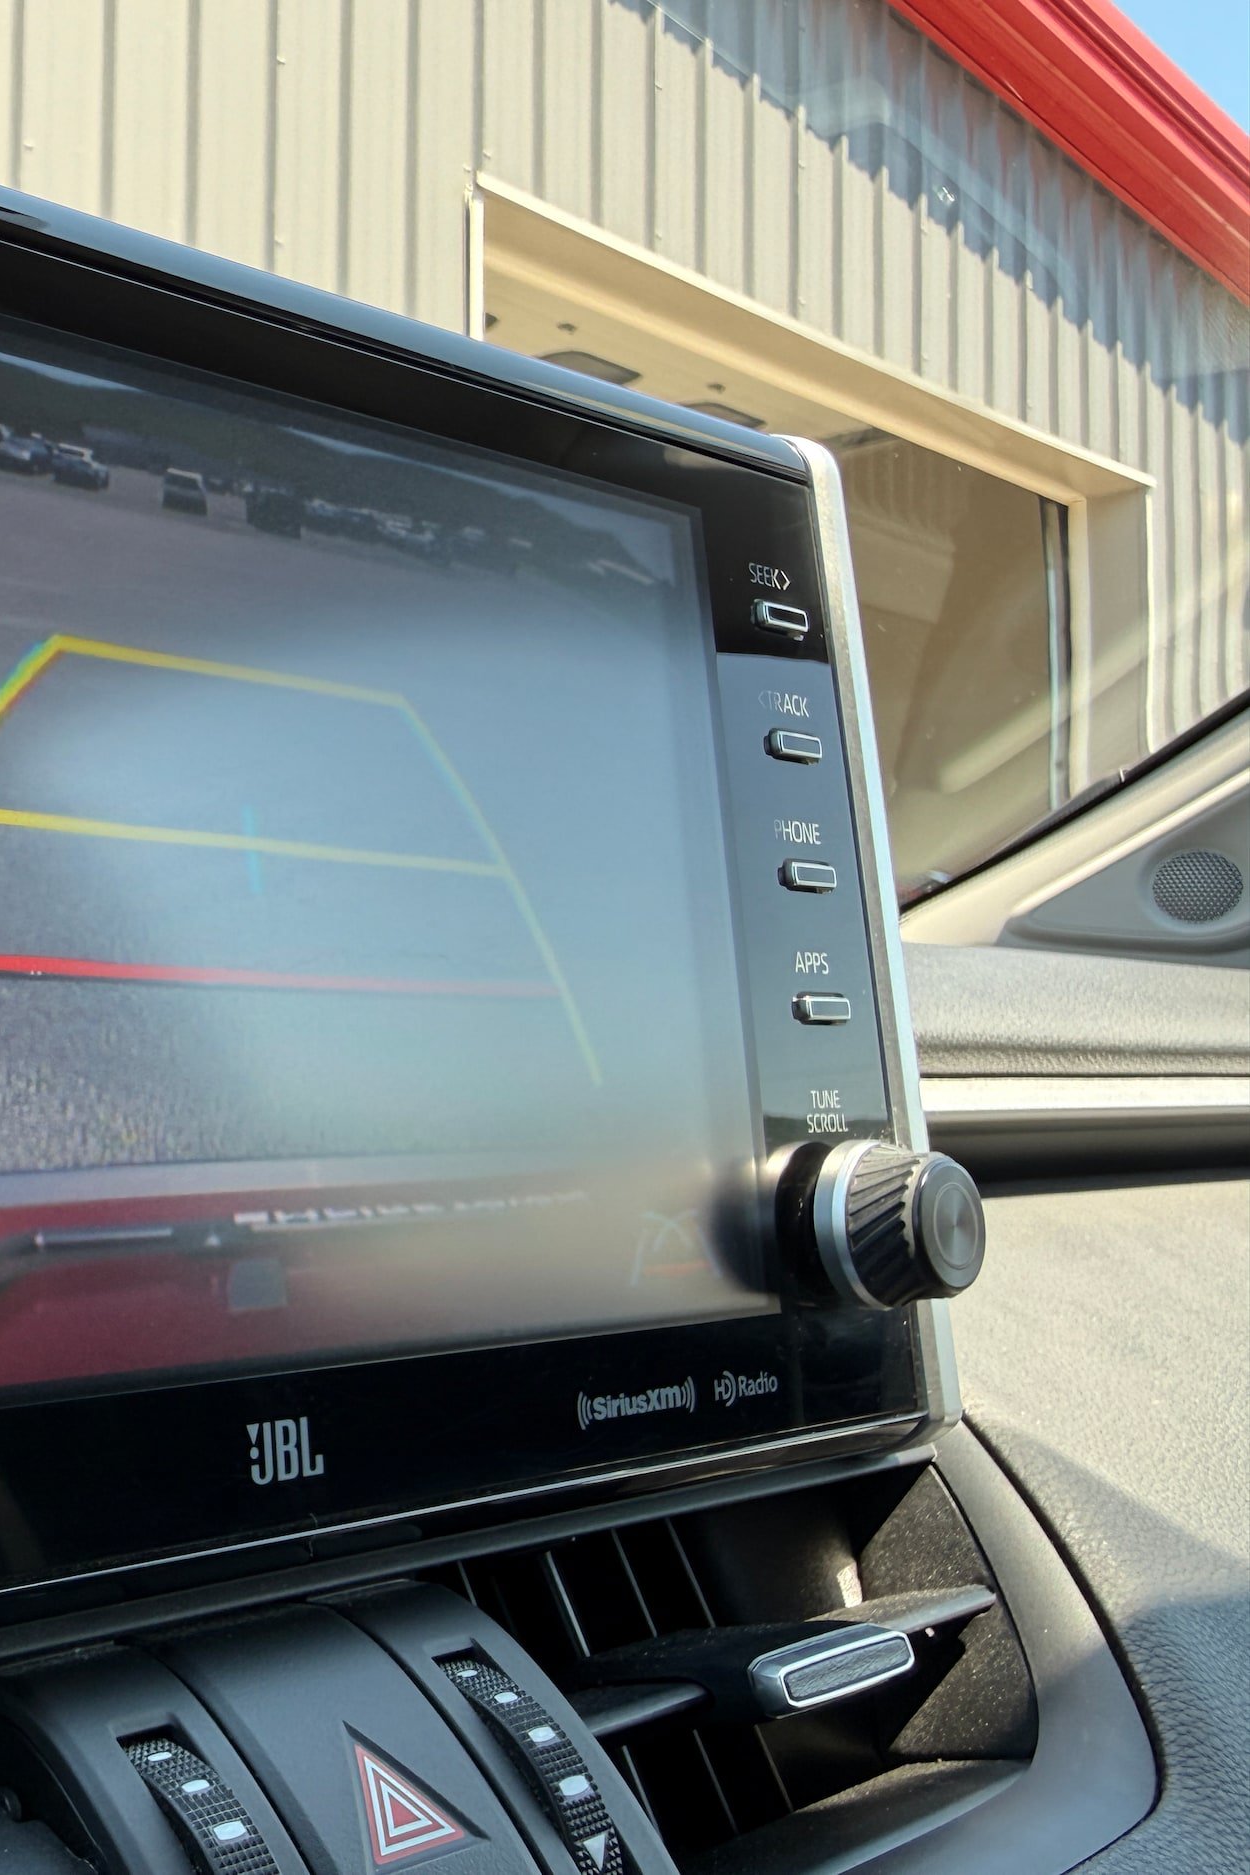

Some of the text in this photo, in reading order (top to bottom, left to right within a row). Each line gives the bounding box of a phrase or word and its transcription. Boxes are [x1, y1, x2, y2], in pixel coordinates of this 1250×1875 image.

[773, 818, 822, 845] PHONE
[795, 951, 829, 975] APPS
[810, 1089, 841, 1109] TUNE
[806, 1112, 849, 1133] SCROLL
[713, 1370, 778, 1404] HD Radio
[249, 1416, 325, 1485] JBL
